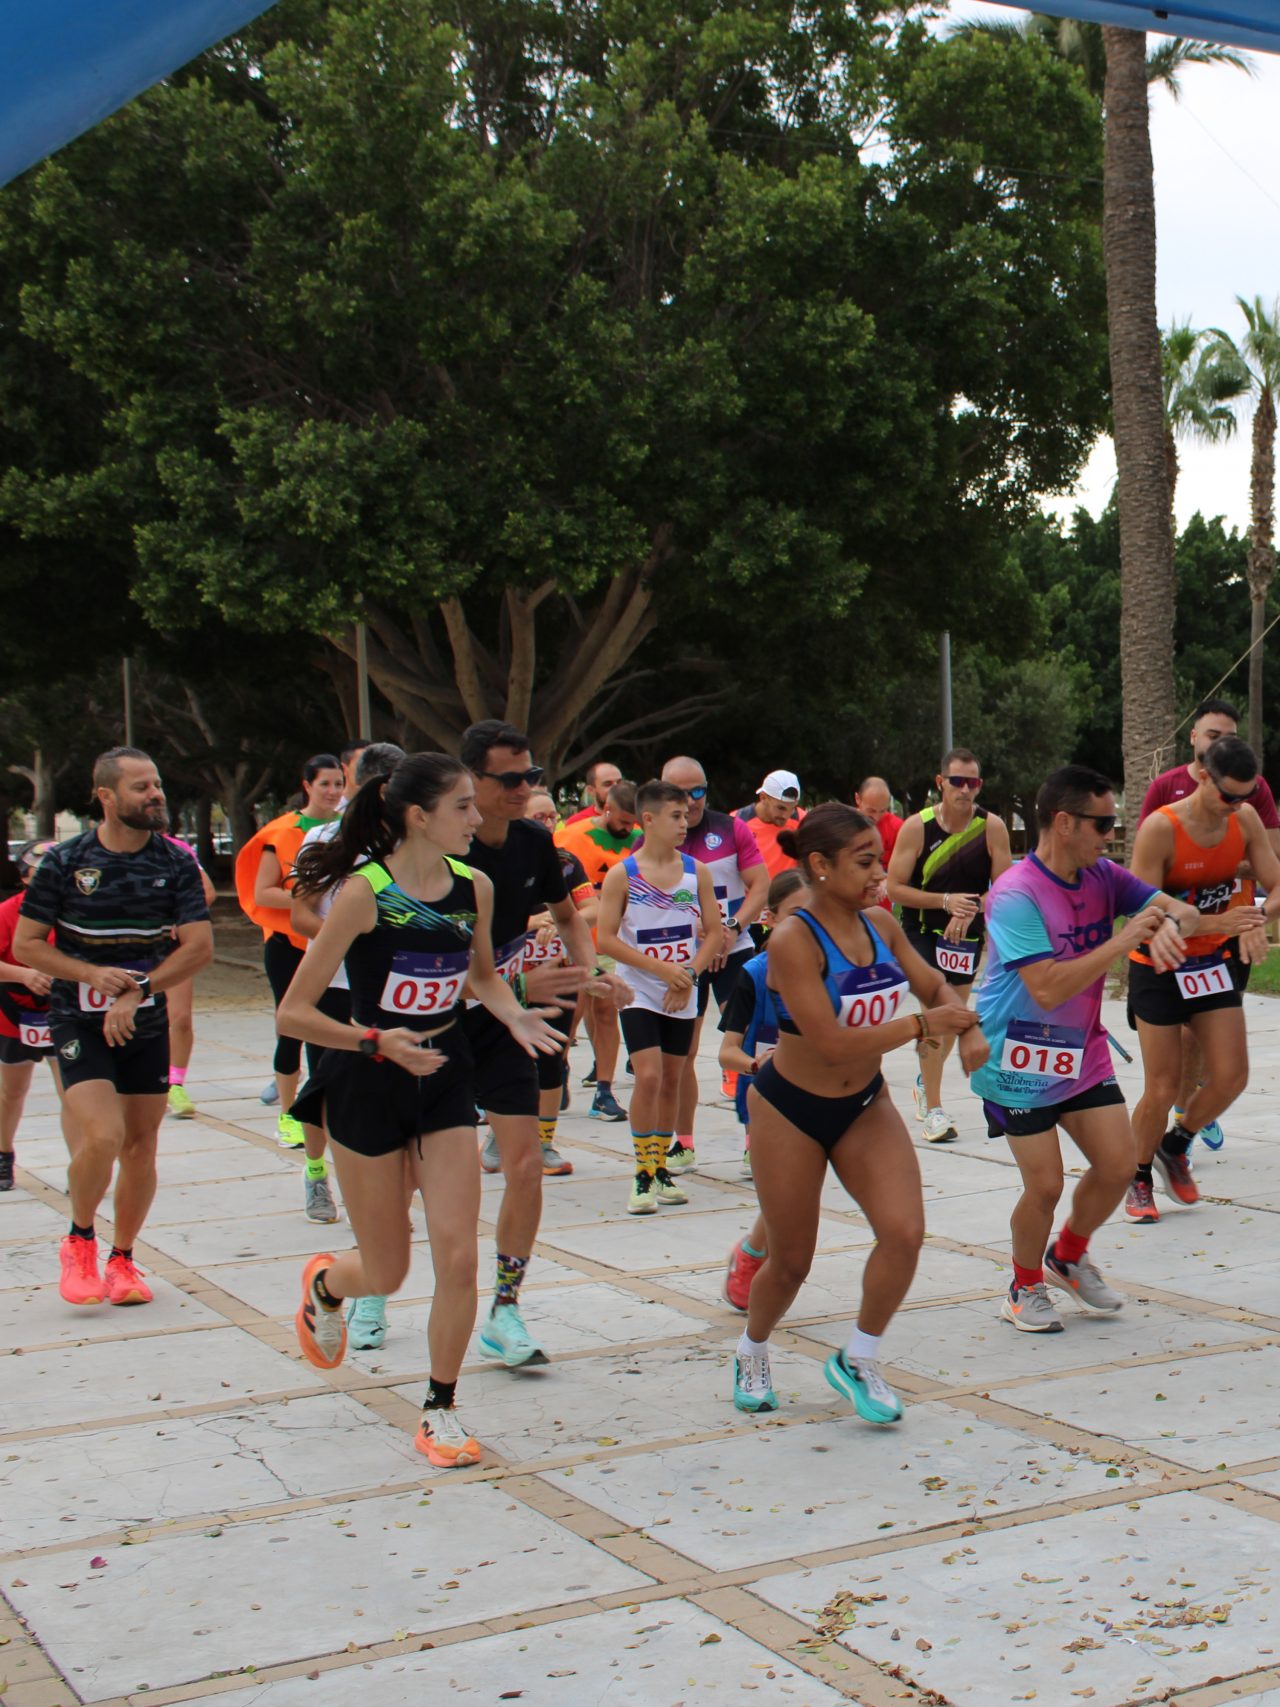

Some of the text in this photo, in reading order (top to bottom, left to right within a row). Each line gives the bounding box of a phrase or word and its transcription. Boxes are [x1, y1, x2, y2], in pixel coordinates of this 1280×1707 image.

[524, 939, 562, 960] 033
[939, 951, 970, 972] 004
[392, 978, 460, 1012] 032
[1182, 968, 1226, 996] 011
[846, 990, 901, 1028] 001
[26, 1028, 54, 1045] 04
[1010, 1045, 1074, 1076] 018
